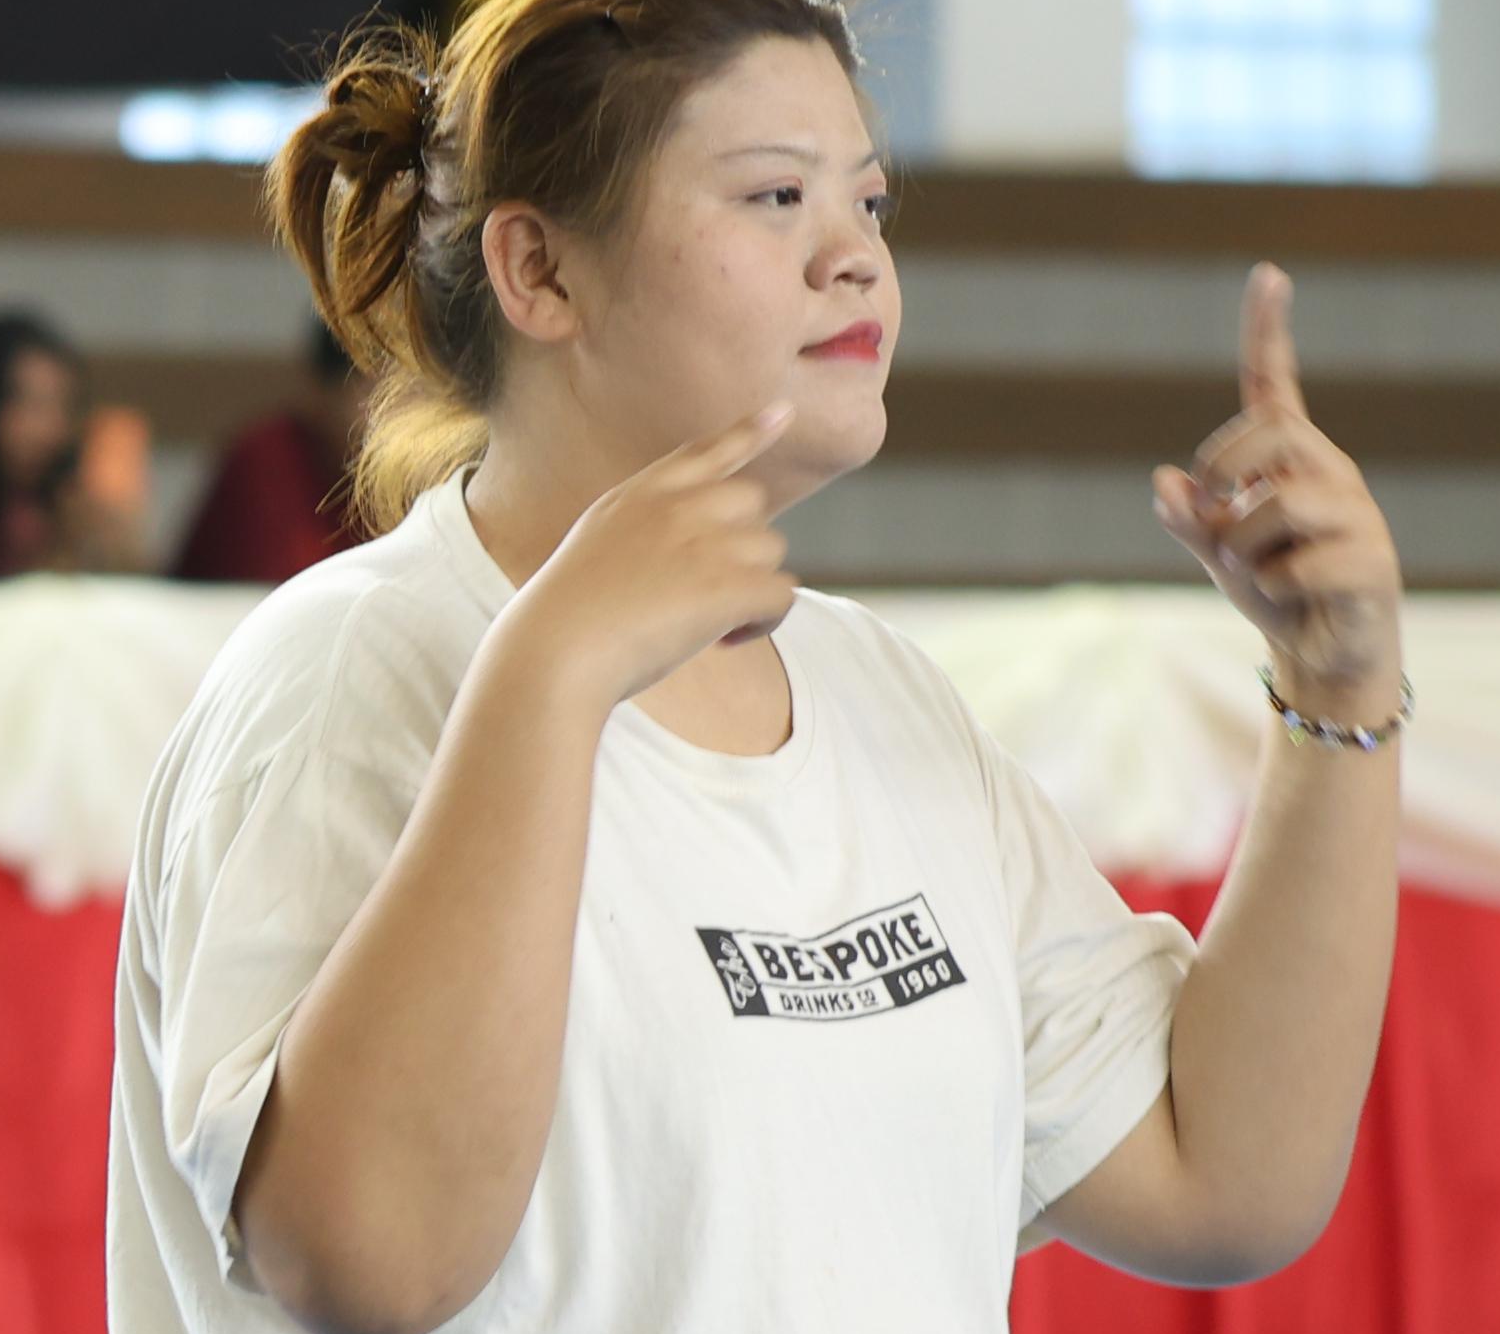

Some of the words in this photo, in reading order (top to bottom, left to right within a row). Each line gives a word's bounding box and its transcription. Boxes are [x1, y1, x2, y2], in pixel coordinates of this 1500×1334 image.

[752, 912, 935, 981] BESPOKE
[897, 958, 952, 999] 1960
[778, 991, 855, 1014] DRINKS
